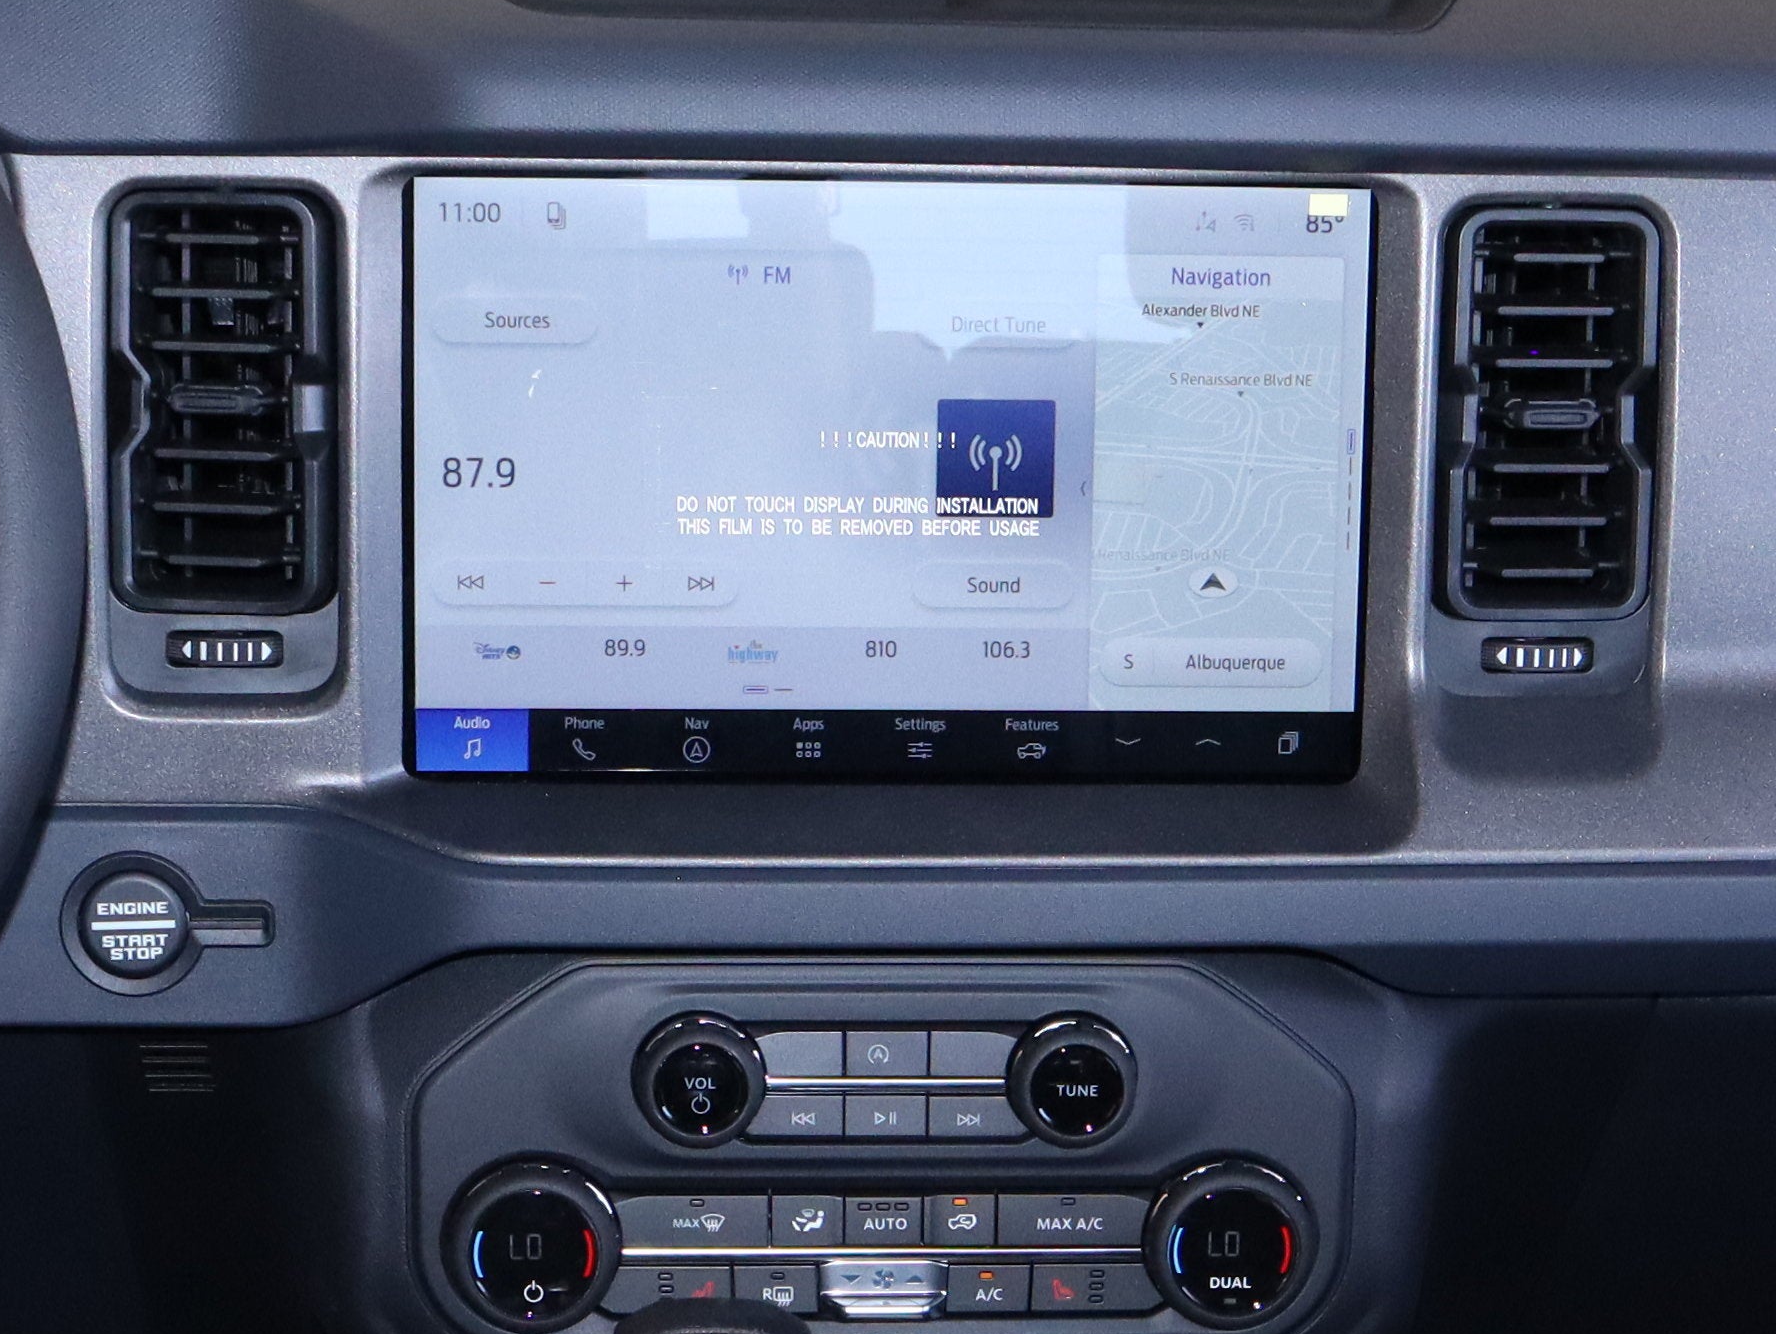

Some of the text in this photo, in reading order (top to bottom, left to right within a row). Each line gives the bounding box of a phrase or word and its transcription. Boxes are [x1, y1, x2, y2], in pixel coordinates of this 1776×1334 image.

[438, 202, 502, 223] 11:00
[763, 266, 792, 285] FM
[1170, 266, 1272, 289] Navigation
[1141, 303, 1260, 318] Alexander Blvd NE
[484, 311, 551, 329] Sources
[951, 316, 1047, 334] Direct Tune
[1169, 373, 1313, 387] S Renaissance Blvd NE
[441, 456, 516, 489] 87.9
[677, 496, 1039, 515] DO NOT TOUCH DISPLAY DURING INSTALLATION
[678, 518, 1040, 536] THIS FILM IS TO BE REMOVED BEFORE USAGE
[966, 576, 1021, 594] Sound
[604, 639, 646, 658] 89.9
[727, 645, 779, 664] highway
[865, 640, 897, 658] 810
[982, 640, 1031, 659] 106.3
[1123, 654, 1134, 669] S
[1185, 653, 1286, 674] Albuquerque
[453, 716, 490, 730] Audio
[564, 716, 605, 730] Phone
[685, 717, 709, 730] Nav
[793, 717, 824, 733] Apps
[895, 717, 946, 734] Settings
[1005, 718, 1059, 732] Features
[97, 902, 168, 916] ENGINE
[102, 934, 168, 948] START
[111, 947, 163, 961] STOP
[683, 1076, 716, 1091] VOL
[1056, 1084, 1098, 1097] TUNE
[672, 1218, 700, 1230] MAX
[862, 1217, 908, 1231] AUTO
[1036, 1216, 1103, 1231] MAX A/C
[1208, 1275, 1251, 1290] DUAL
[975, 1287, 1003, 1301] A/C
